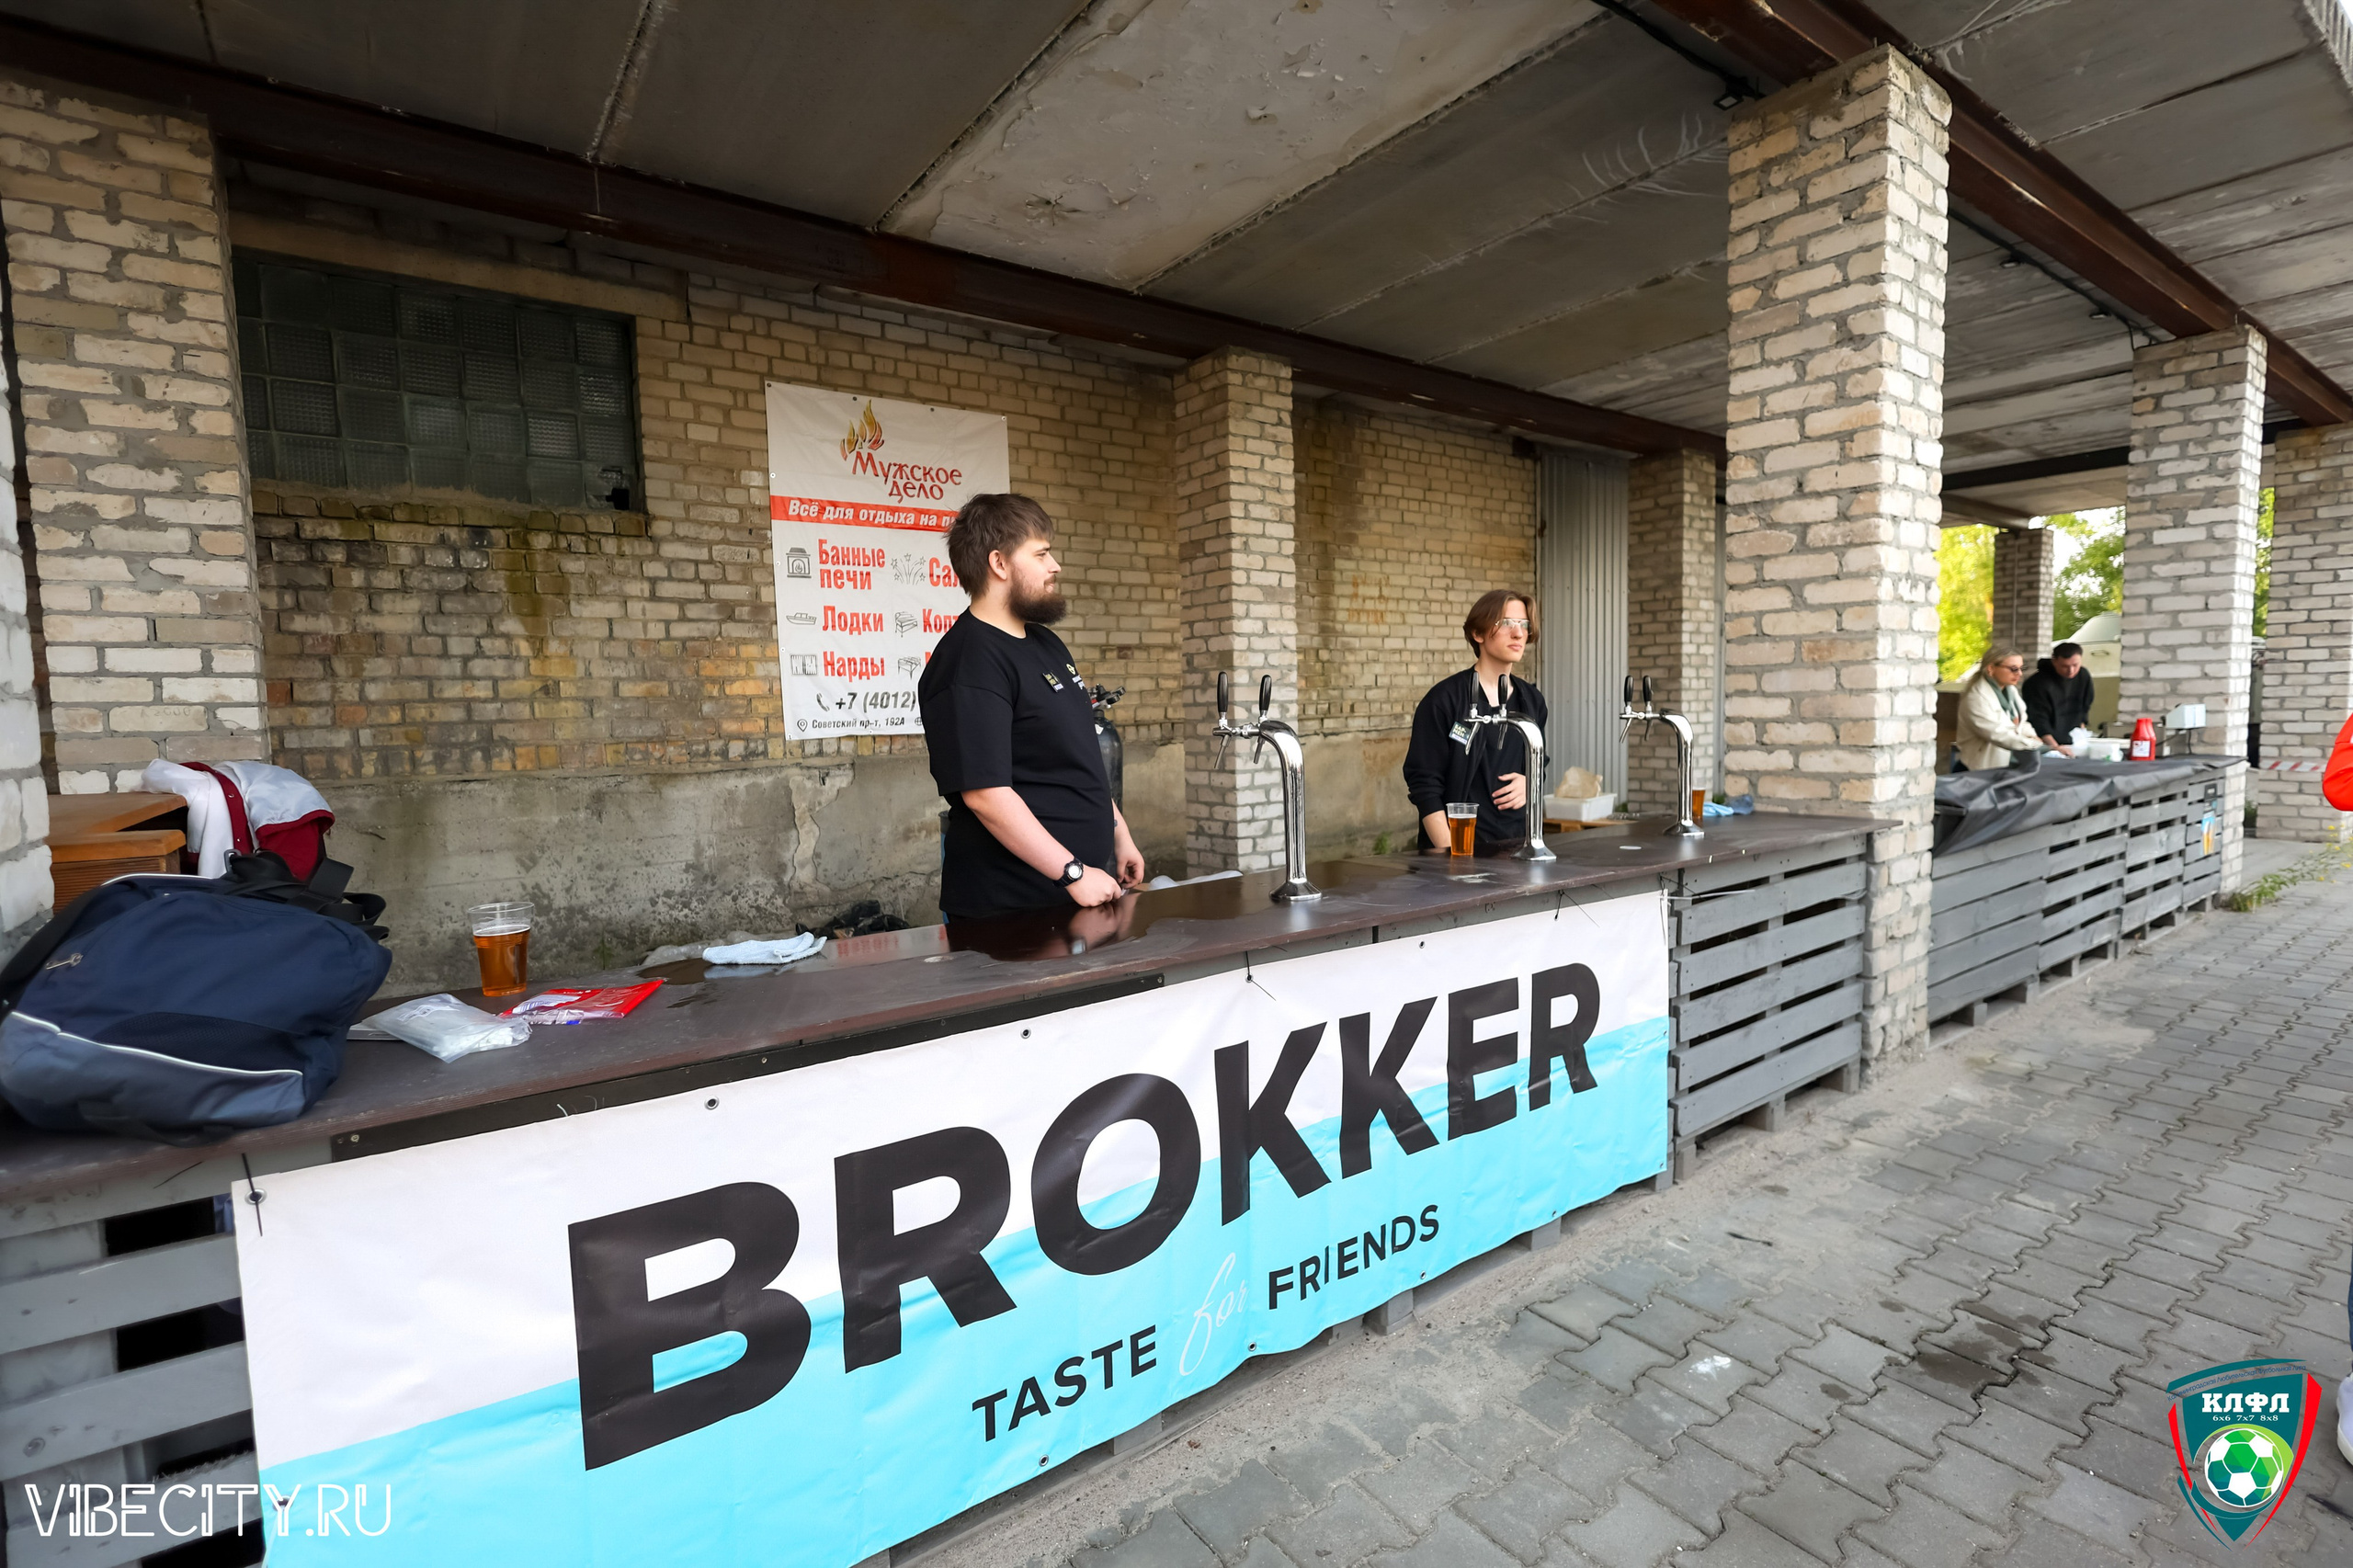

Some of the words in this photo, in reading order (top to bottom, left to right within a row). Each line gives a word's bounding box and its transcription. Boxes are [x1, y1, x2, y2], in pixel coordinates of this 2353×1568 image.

[852, 451, 962, 486] Мужское
[888, 480, 944, 504] дело
[788, 499, 819, 517] Всё
[823, 506, 854, 520] для
[858, 509, 915, 525] отдыха
[919, 514, 938, 527] на
[818, 539, 885, 569] Банные
[820, 568, 872, 590] печи
[822, 605, 884, 636] Лодки
[823, 651, 885, 683] Нарды
[835, 691, 858, 710] +7
[863, 690, 916, 713] (4012)
[812, 718, 858, 729] Советский
[568, 962, 1600, 1471] BROKKER
[972, 1324, 1157, 1442] TASTE
[1179, 1252, 1248, 1376] for
[1268, 1204, 1439, 1310] FRIENDS
